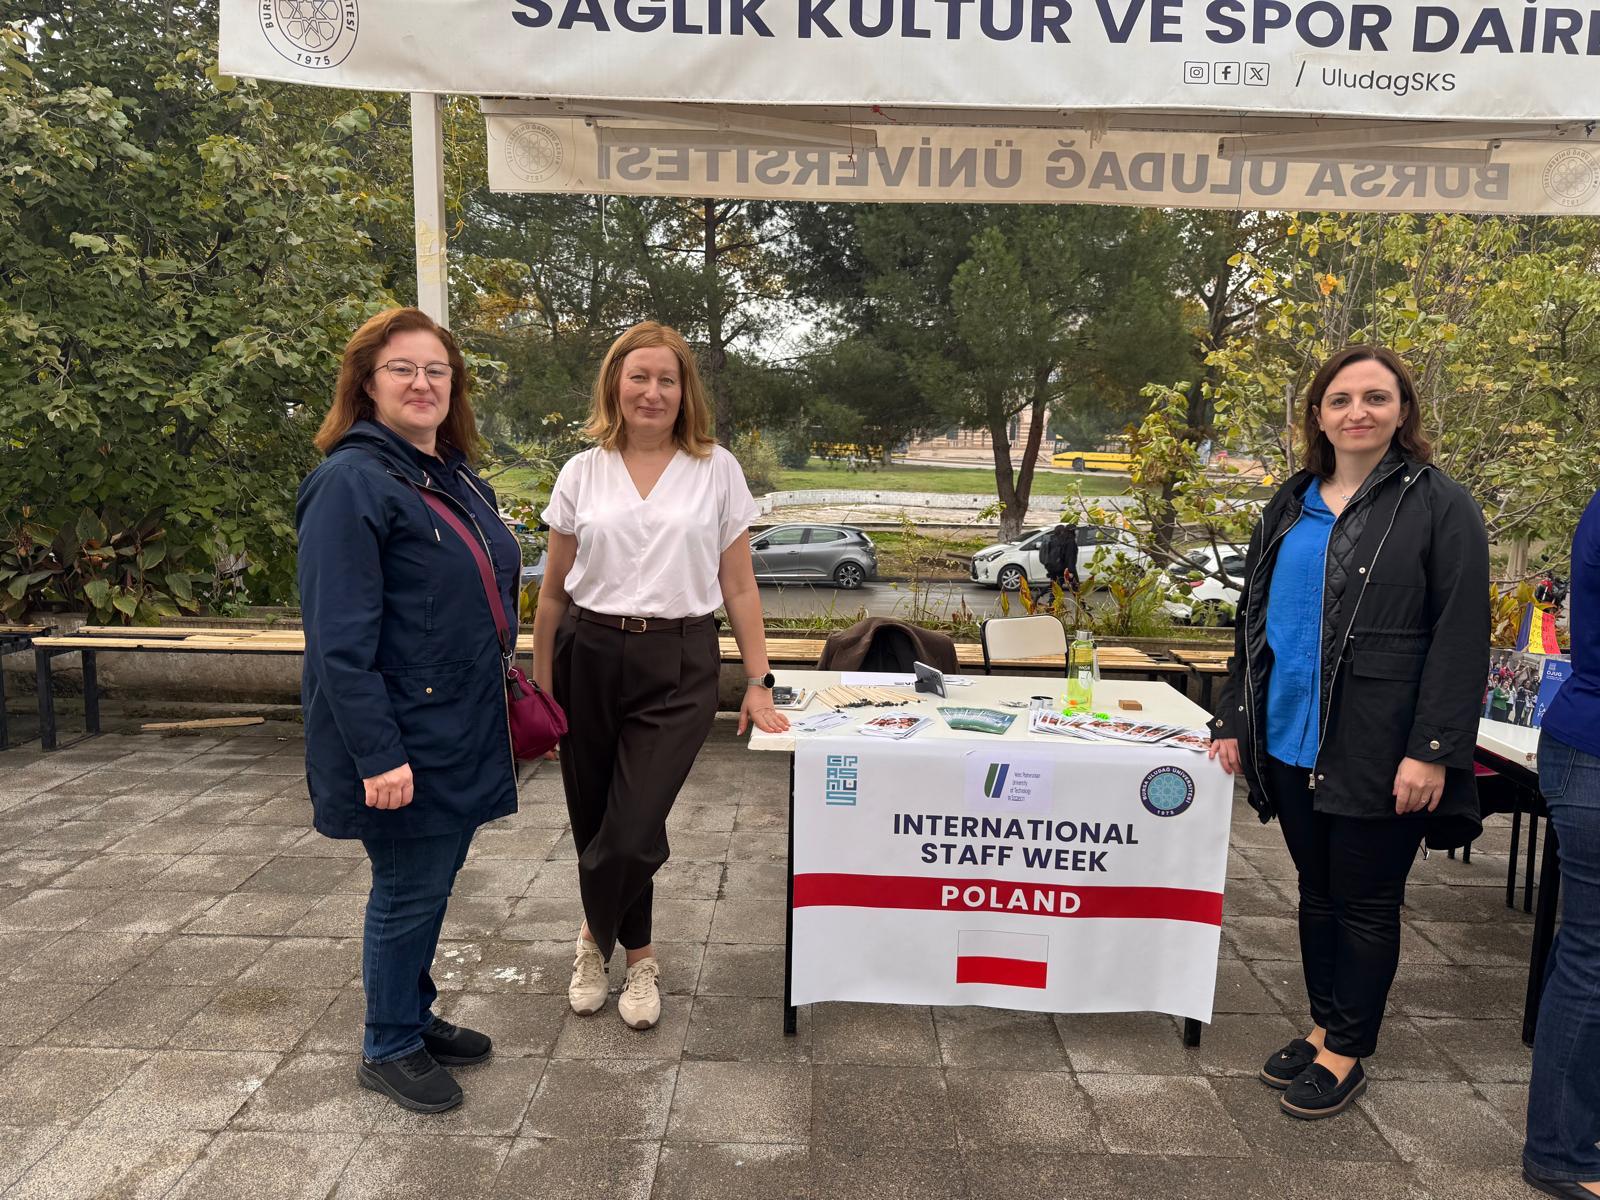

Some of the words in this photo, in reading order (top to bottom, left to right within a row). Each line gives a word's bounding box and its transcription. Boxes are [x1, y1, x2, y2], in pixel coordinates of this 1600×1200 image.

[1095, 0, 1183, 43] VE
[1205, 0, 1392, 51] SPOR
[296, 54, 331, 66] 1975
[1322, 68, 1456, 96] UludagSKS
[893, 813, 1138, 845] INTERNATIONAL
[921, 842, 1013, 866] STAFF
[1022, 847, 1109, 872] WEEK
[941, 885, 1081, 913] POLAND
